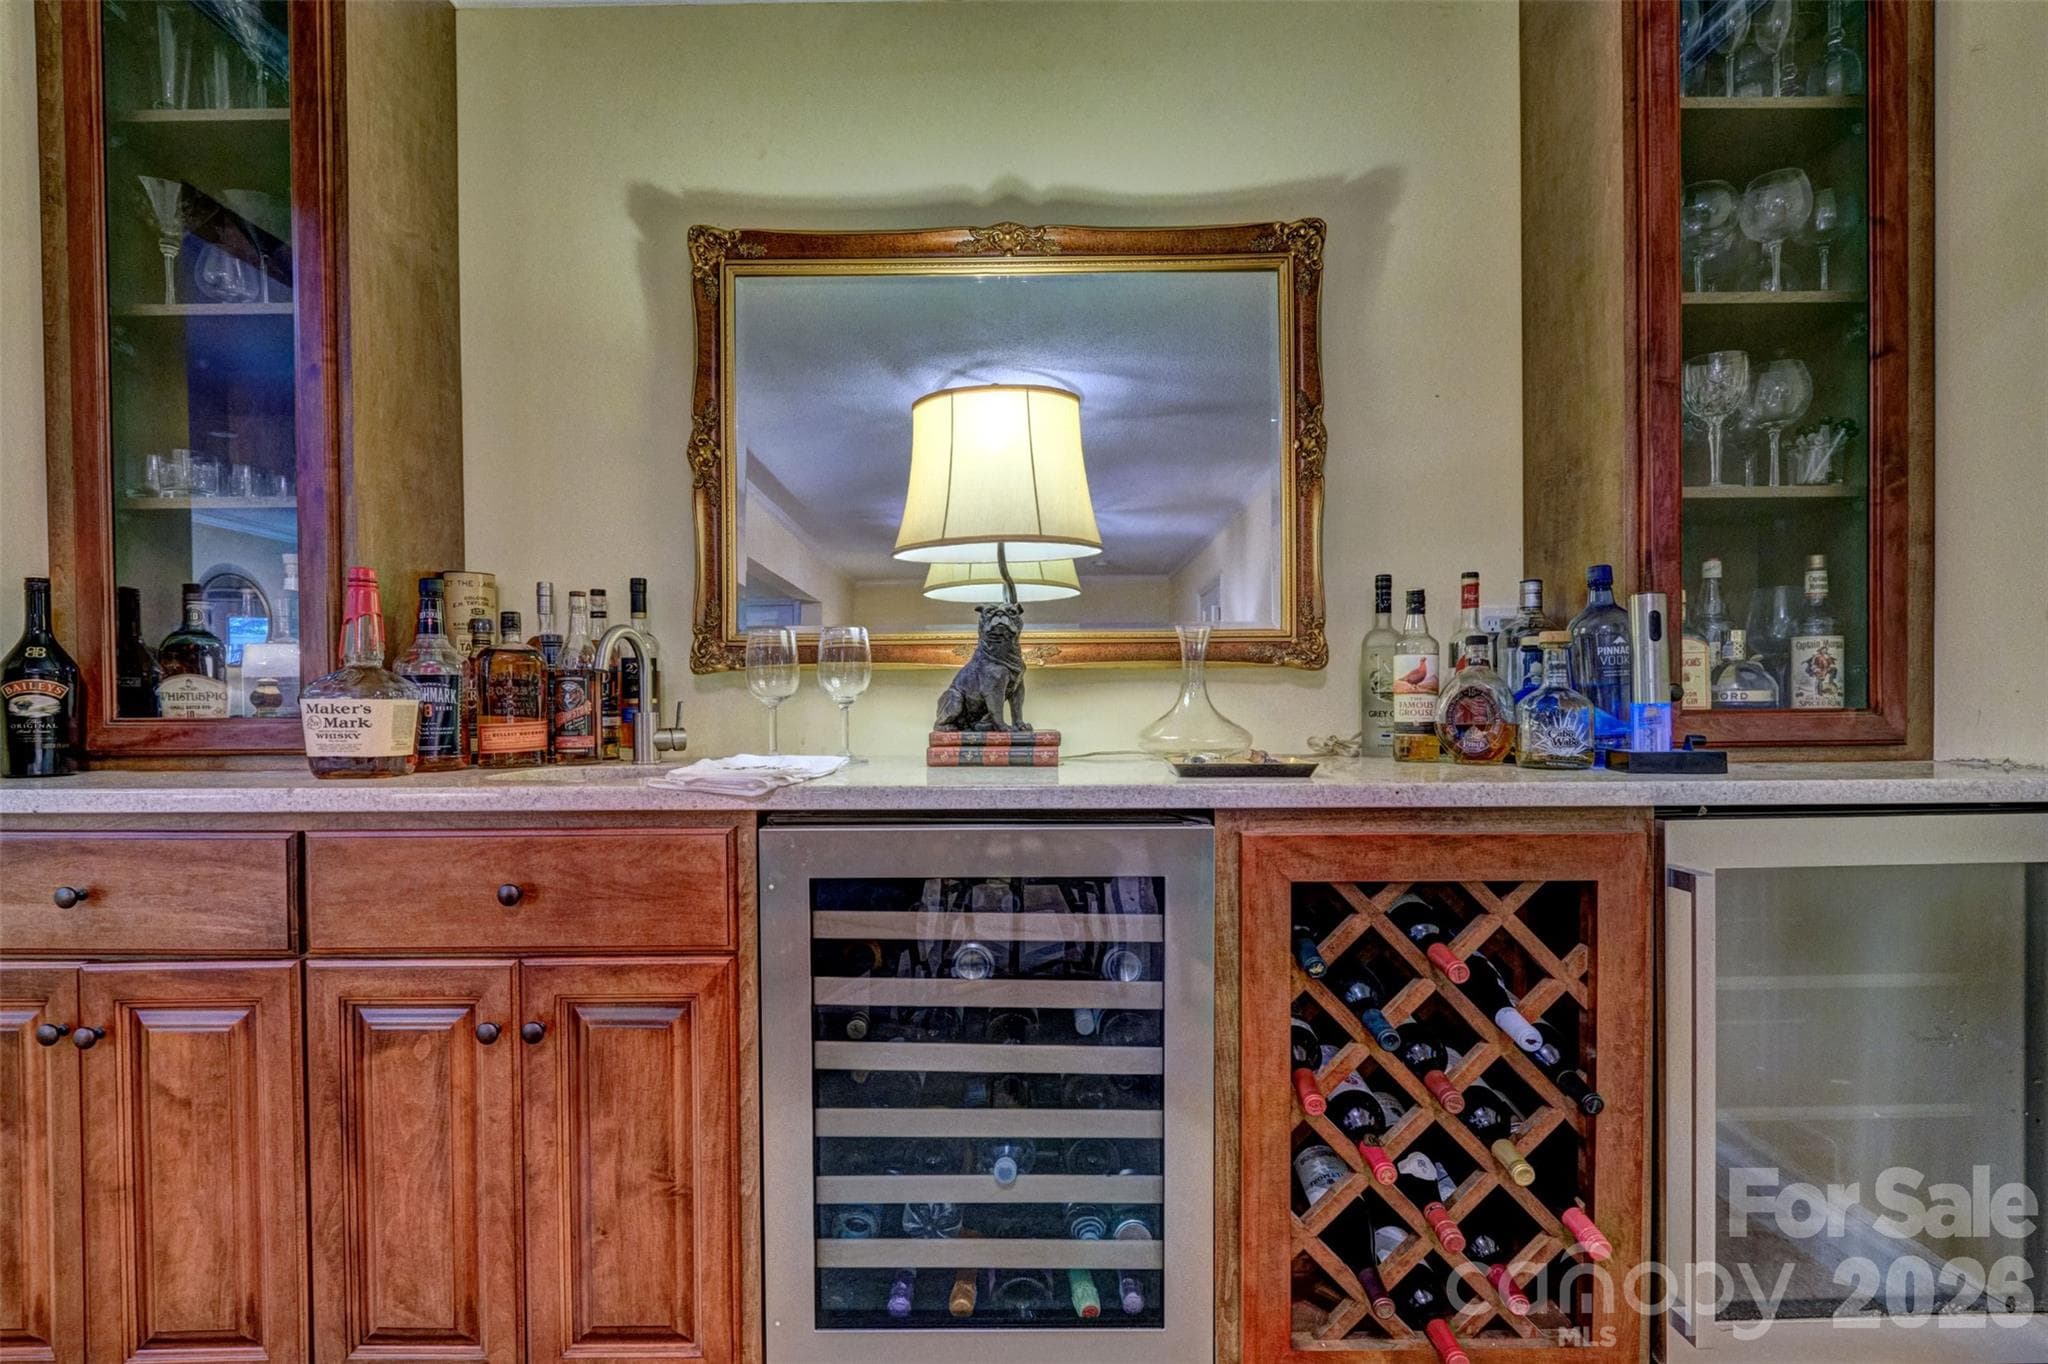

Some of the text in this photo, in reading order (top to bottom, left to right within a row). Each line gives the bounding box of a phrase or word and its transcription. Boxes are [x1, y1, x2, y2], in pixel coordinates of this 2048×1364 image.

[1599, 655, 1630, 666] VODK
[4, 682, 63, 695] BAILEYS
[306, 703, 372, 714] Maker's
[1368, 710, 1388, 718] GREY
[1399, 708, 1434, 716] GROUSE
[323, 717, 373, 729] Mark
